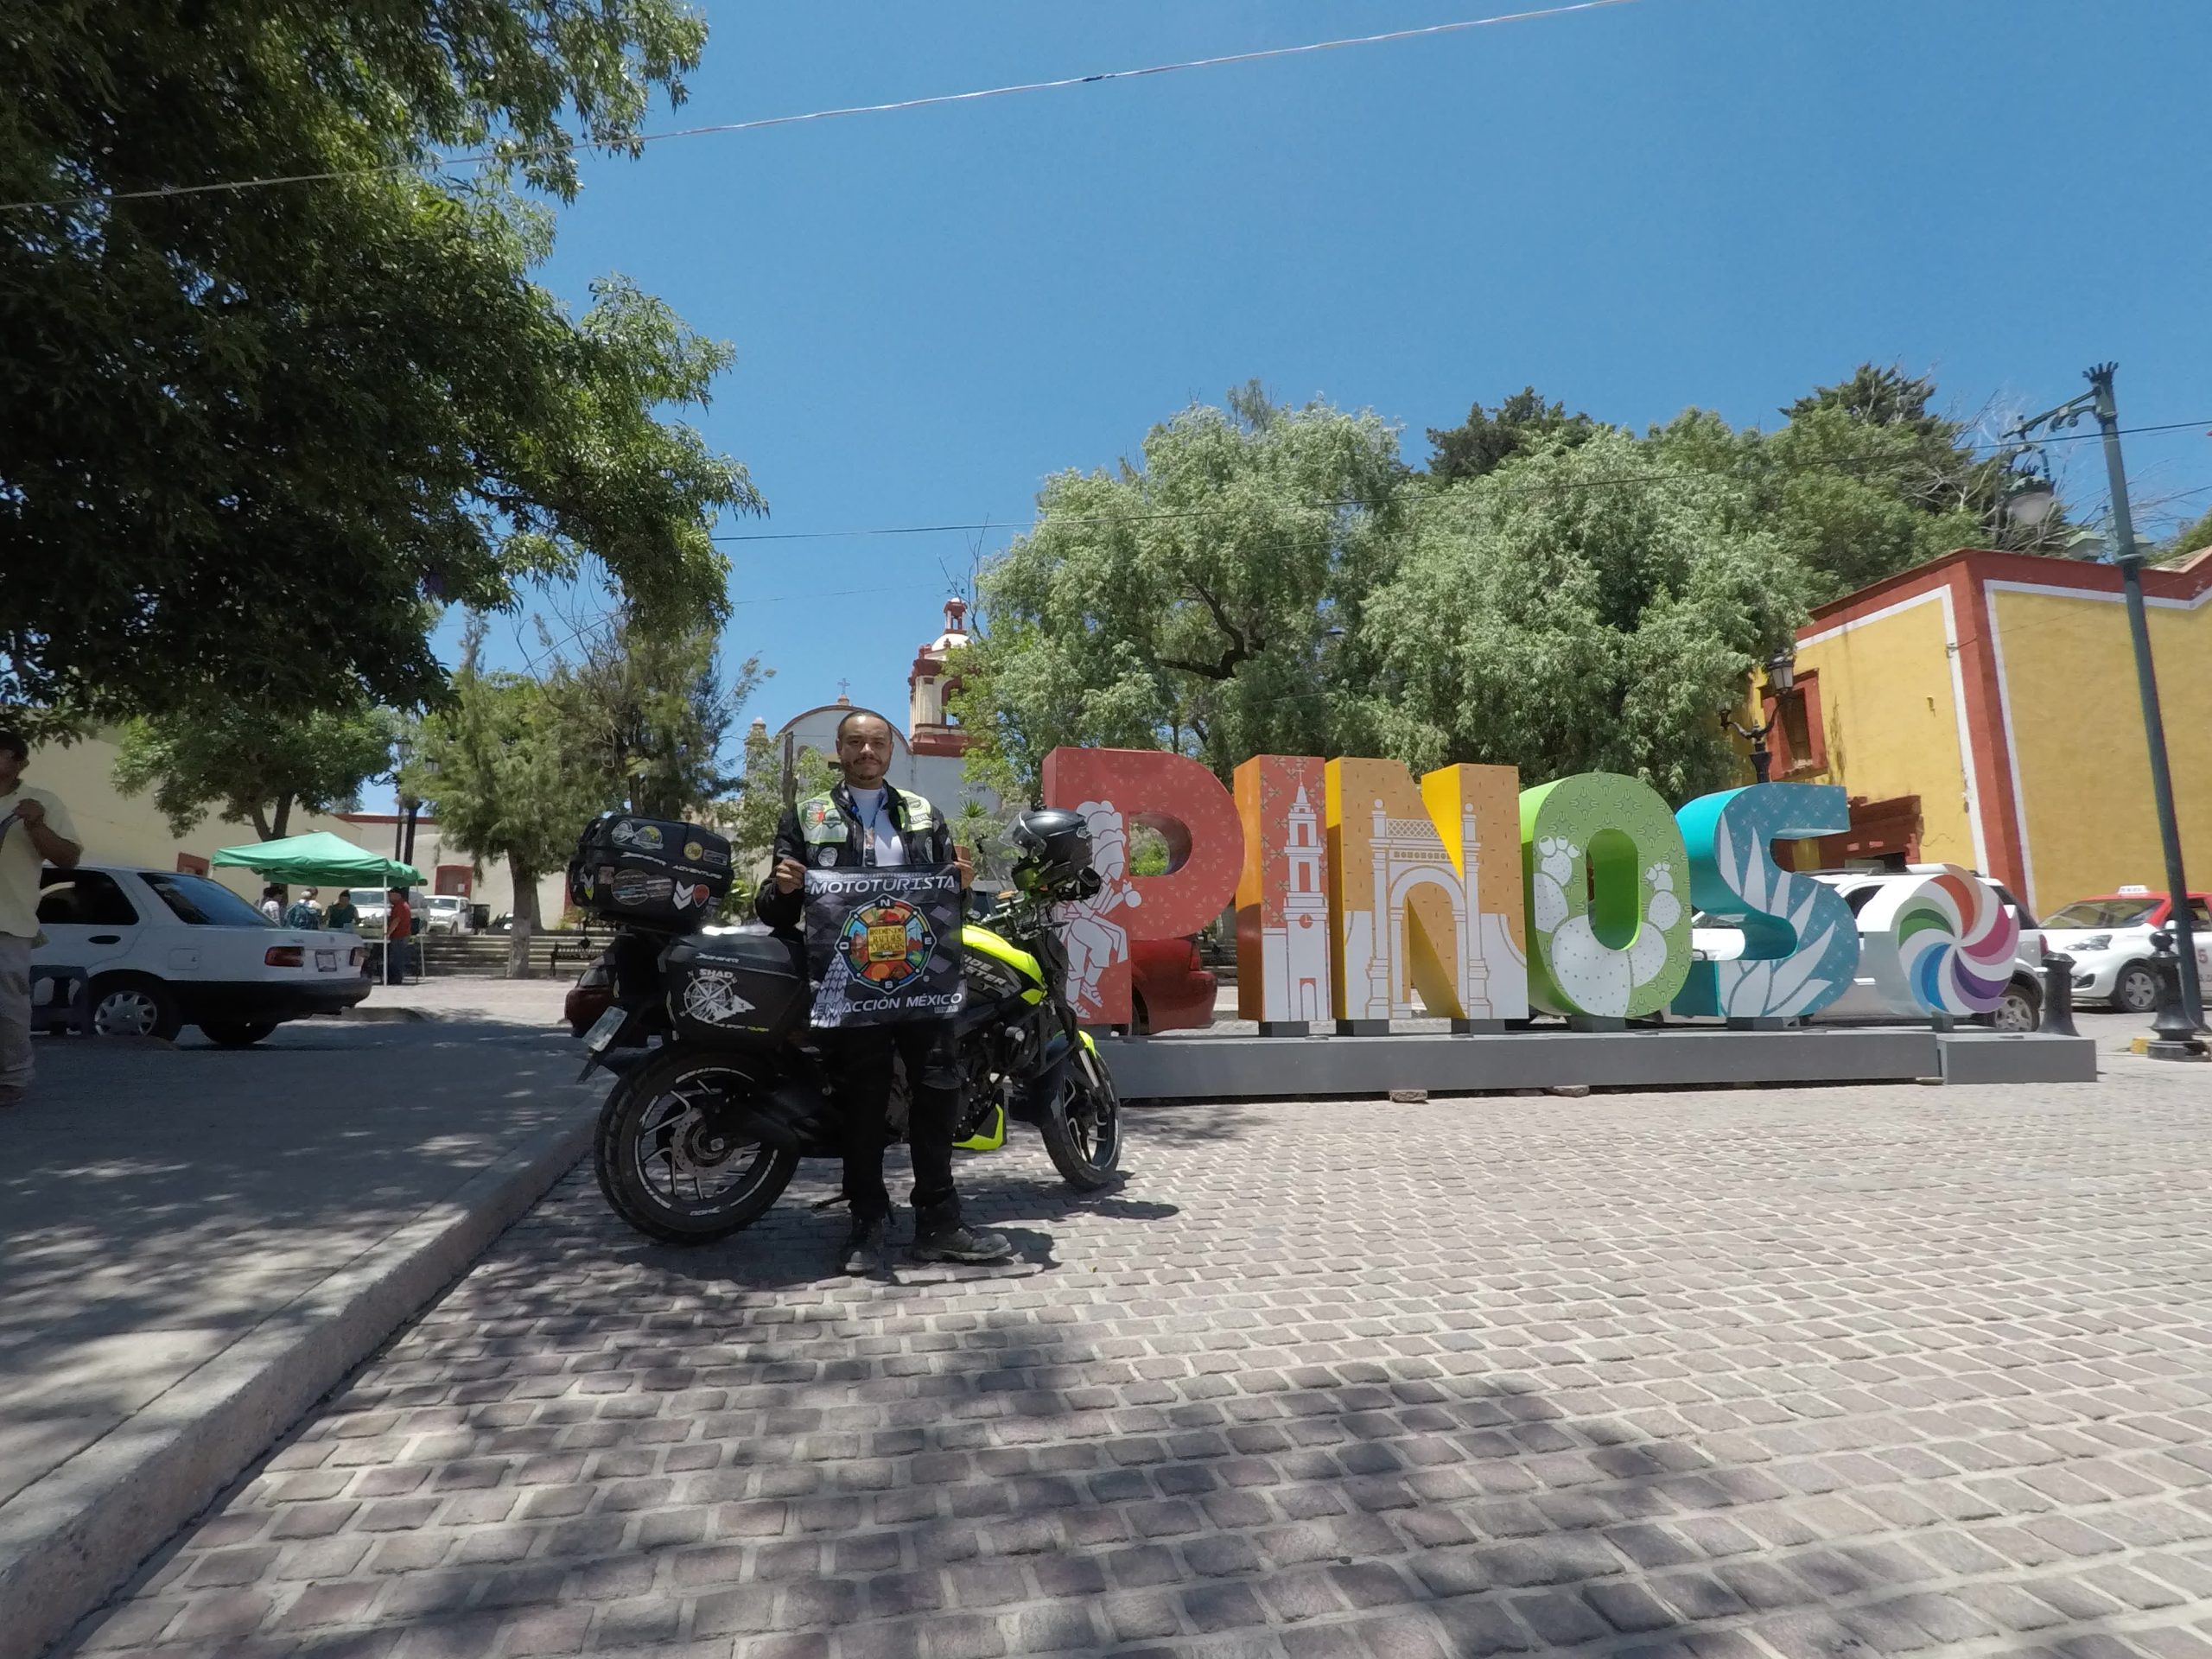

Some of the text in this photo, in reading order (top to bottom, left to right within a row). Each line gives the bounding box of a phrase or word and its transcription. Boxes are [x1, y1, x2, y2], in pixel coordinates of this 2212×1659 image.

[810, 875, 956, 895] MOTOTURISTA
[1042, 747, 1858, 1027] PINOS
[880, 899, 891, 907] N
[924, 937, 932, 945] E
[963, 954, 994, 972] IDE
[699, 968, 734, 979] SHAD
[961, 963, 1007, 986] STER
[884, 980, 894, 989] S
[815, 993, 963, 1015] EN ACCIÓN MÉXICO
